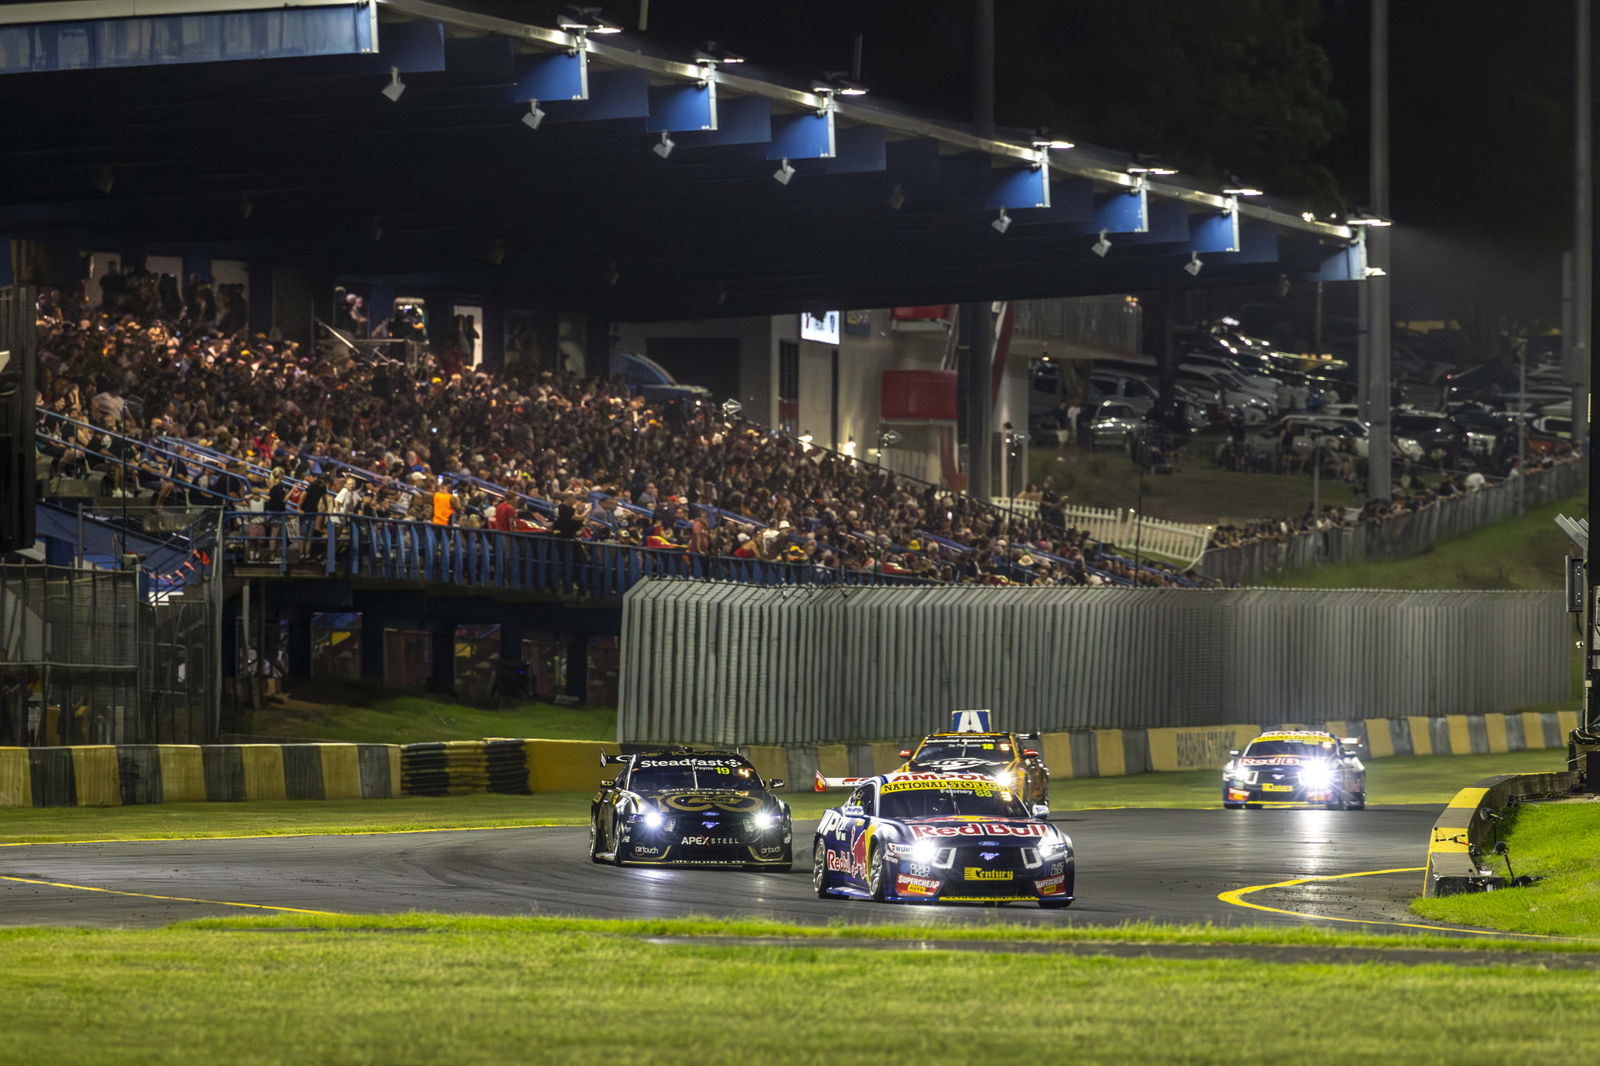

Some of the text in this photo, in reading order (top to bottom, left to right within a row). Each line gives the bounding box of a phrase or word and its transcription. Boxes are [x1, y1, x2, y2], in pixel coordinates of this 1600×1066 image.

[640, 758, 725, 768] Steadfast
[714, 766, 730, 775] 19
[738, 768, 750, 778] 4
[892, 773, 994, 782] AMPOL
[883, 781, 949, 792] NATIONAL
[1000, 791, 1013, 802] 3
[907, 823, 1049, 839] Red Bull
[681, 836, 710, 846] APEX
[898, 875, 940, 889] SUPERCHEAP
